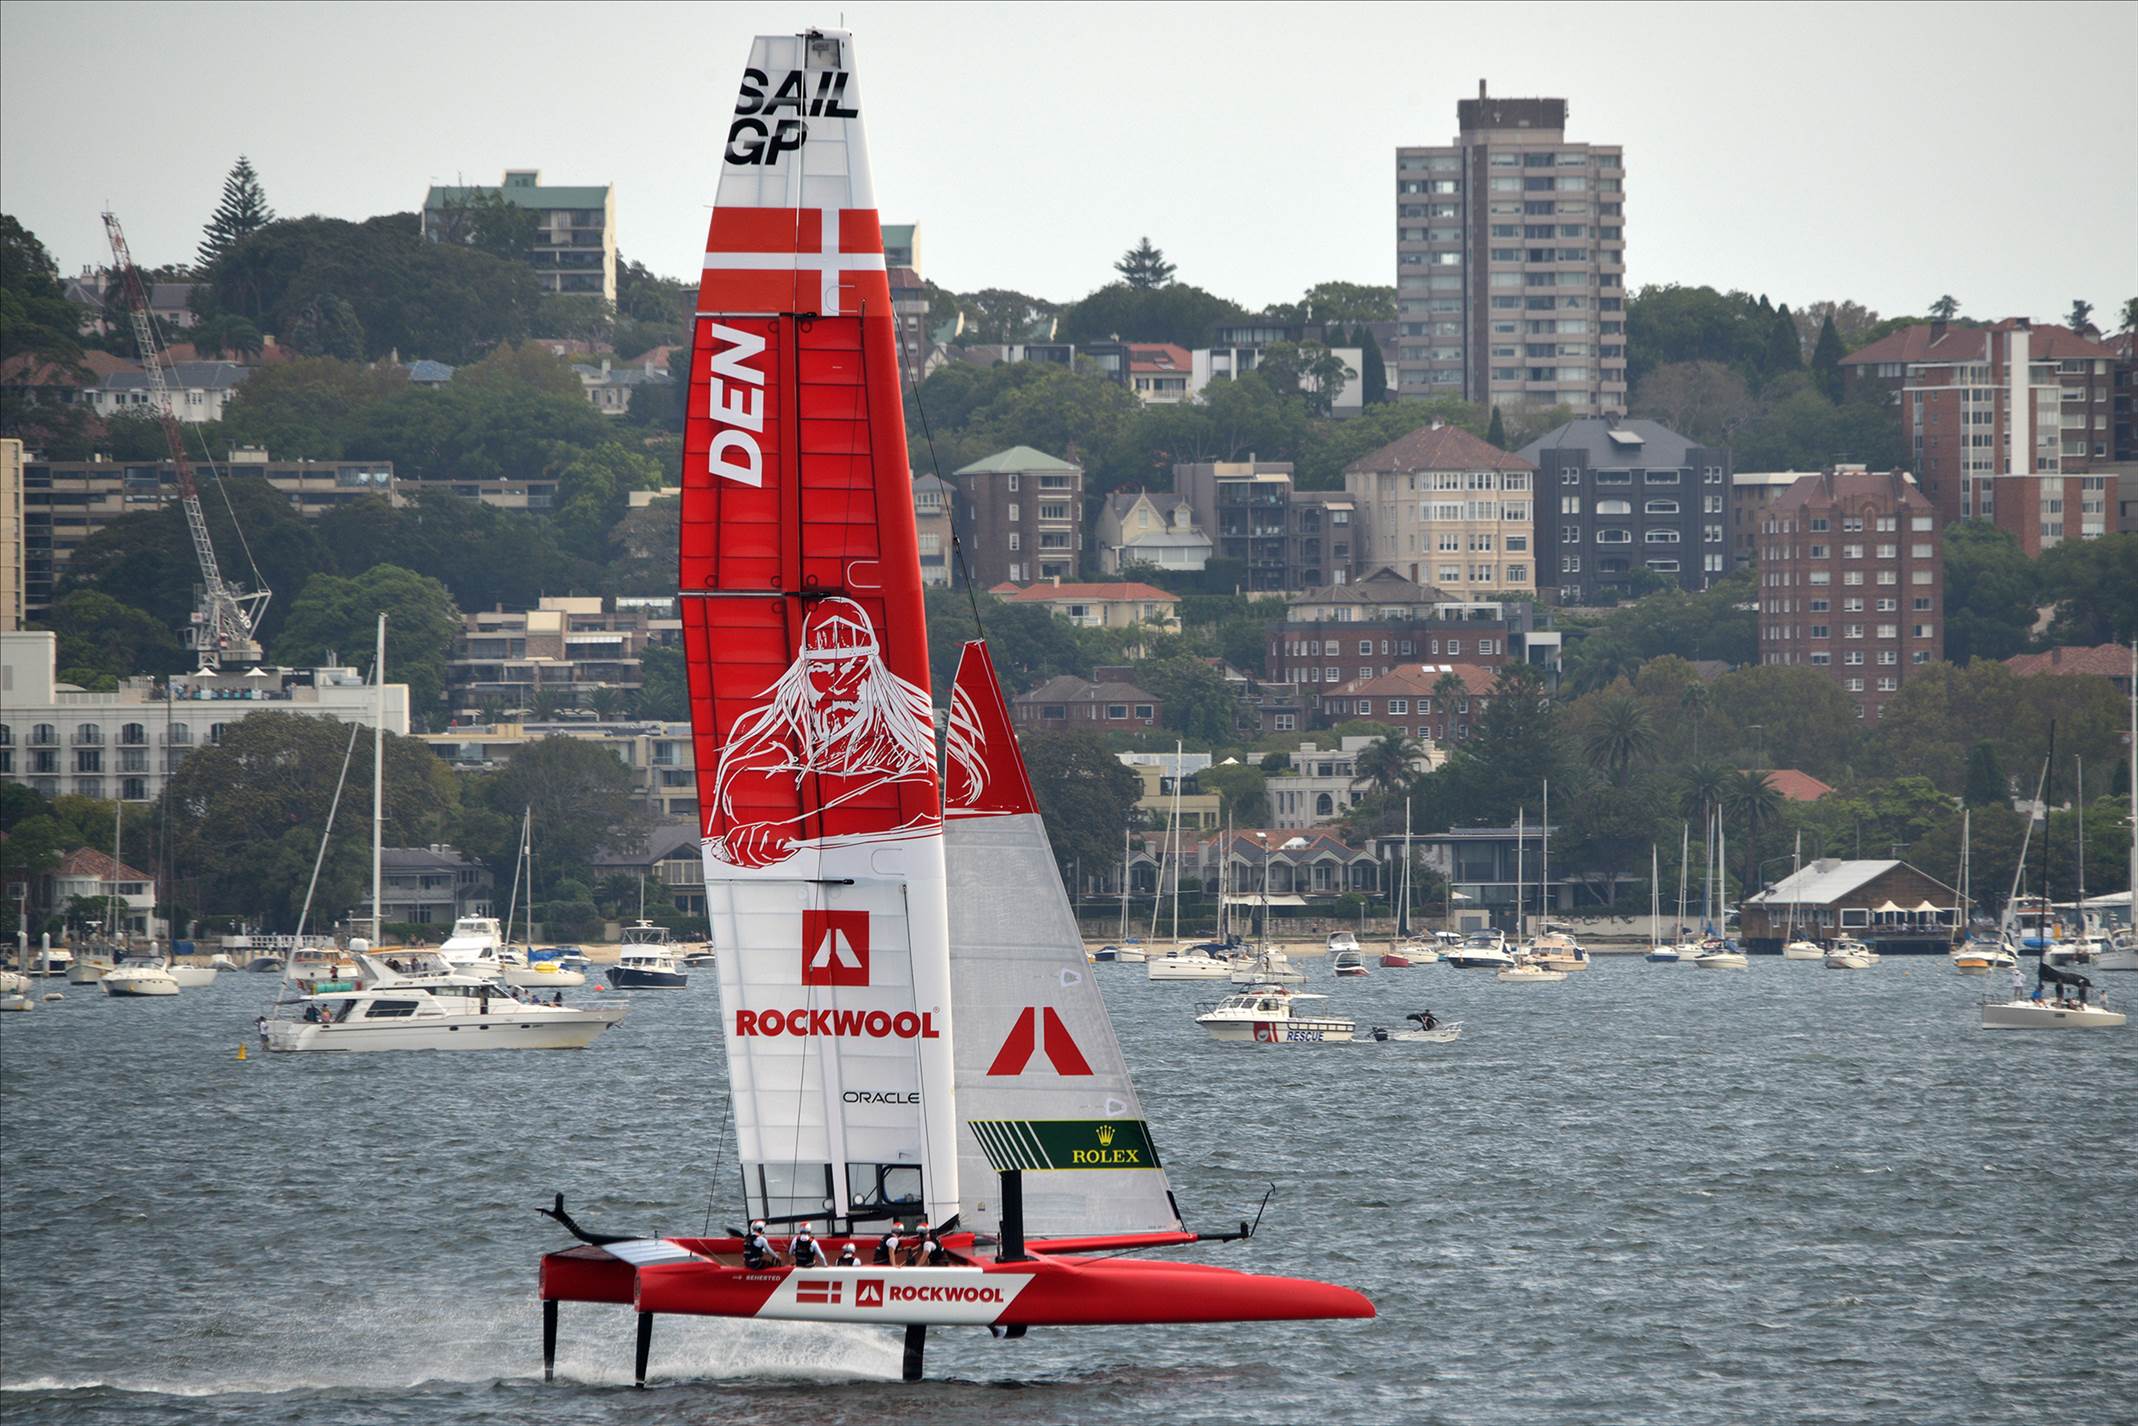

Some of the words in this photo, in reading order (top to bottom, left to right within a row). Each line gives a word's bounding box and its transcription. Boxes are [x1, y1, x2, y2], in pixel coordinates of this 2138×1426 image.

[734, 67, 859, 118] SAIL
[724, 117, 809, 166] GP
[708, 322, 766, 489] DEN
[736, 1008, 940, 1039] ROCKWOOL
[1286, 1031, 1325, 1042] RESCUE
[842, 1091, 921, 1104] ORACLE
[1072, 1149, 1140, 1164] ROLEX
[889, 1285, 1004, 1303] ROCKWOOL
